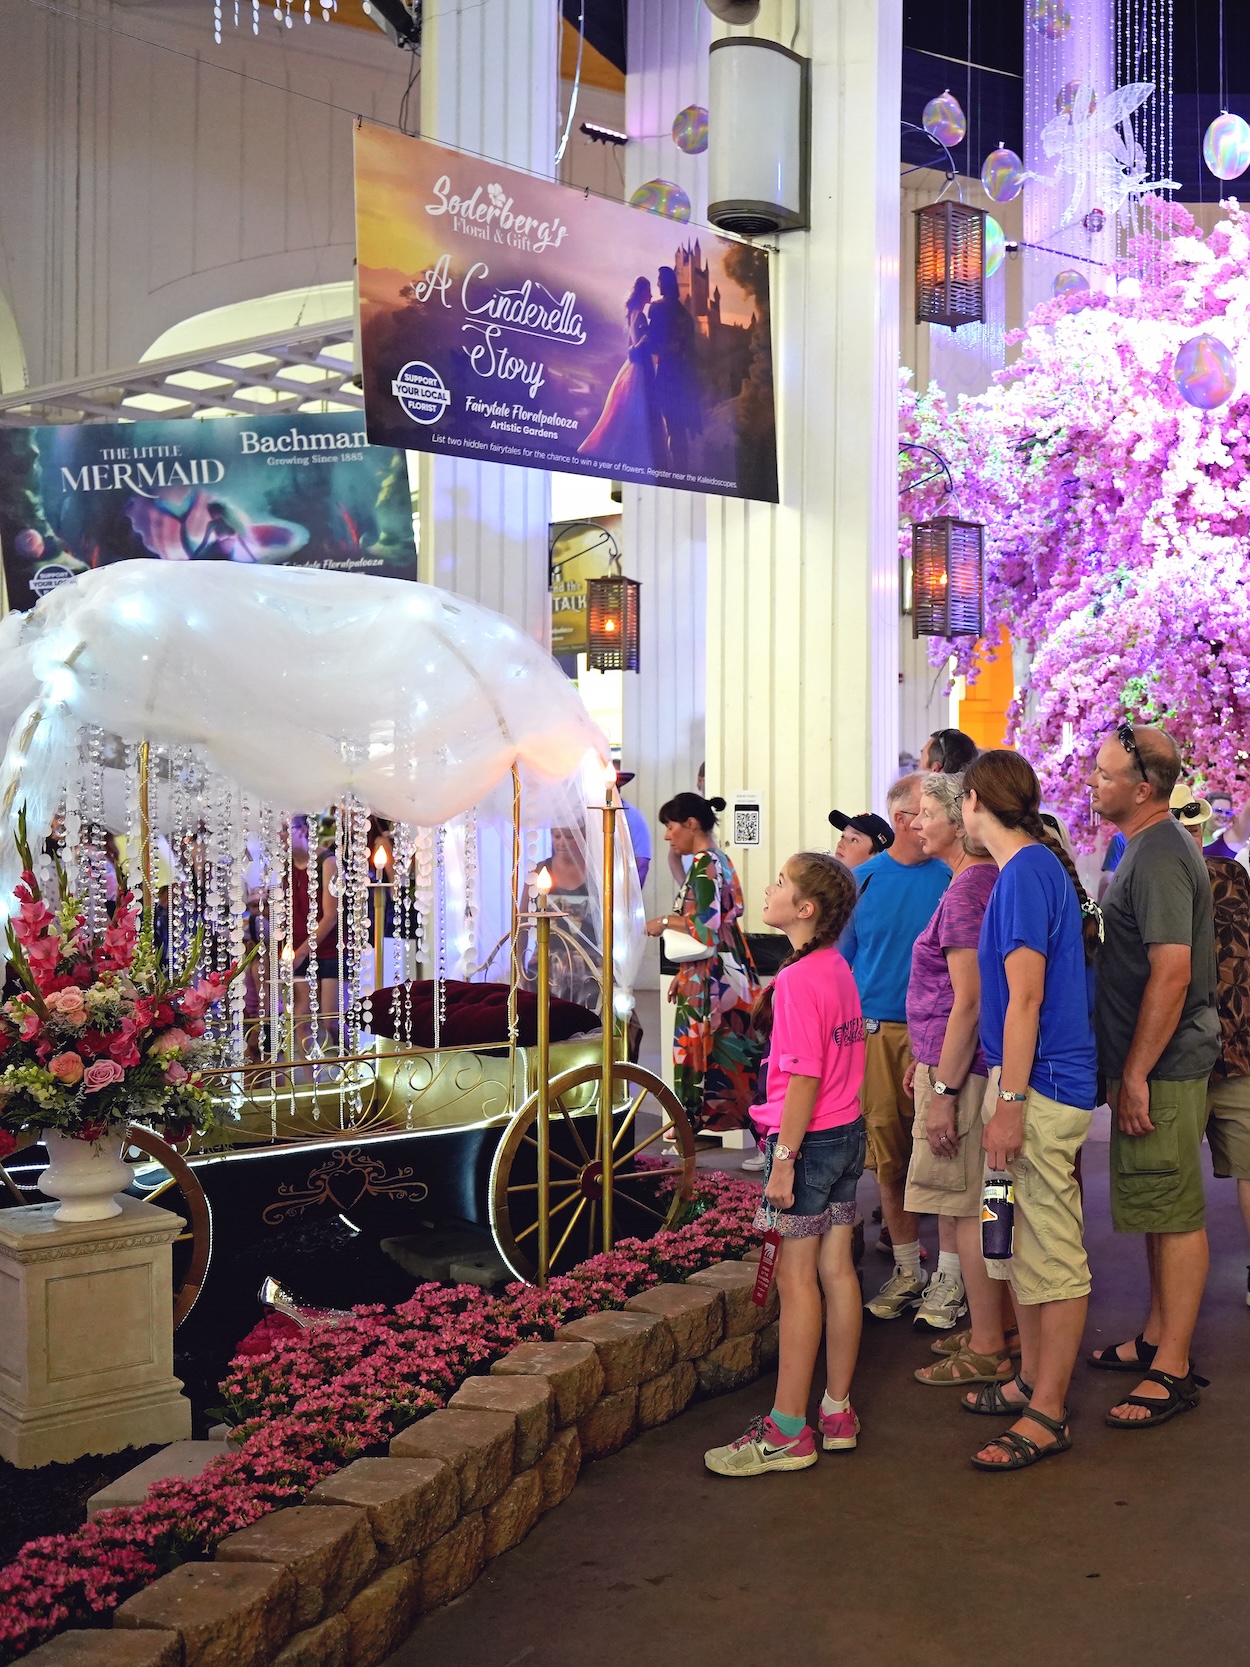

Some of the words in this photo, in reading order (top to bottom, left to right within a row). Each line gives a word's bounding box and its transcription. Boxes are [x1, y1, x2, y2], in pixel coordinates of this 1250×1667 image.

[424, 175, 569, 253] Soderberg's
[453, 216, 490, 242] Floral
[494, 228, 503, 244] &
[506, 231, 532, 251] Gift
[409, 254, 452, 308] A
[461, 262, 587, 345] Cinderella
[461, 322, 545, 399] Story
[396, 385, 419, 397] YOUR
[421, 390, 447, 401] LOCAL
[404, 373, 437, 387] SUPPORT
[408, 401, 437, 413] FLORIST
[465, 395, 510, 418] Fairytale
[512, 404, 579, 429] Floralpalooza
[239, 428, 372, 454] Bachman
[490, 420, 522, 434] Artistic
[523, 426, 558, 440] Gardens
[100, 446, 131, 462] THE
[133, 444, 182, 460] LITTLE
[267, 455, 309, 466] Growing
[312, 454, 338, 463] Since
[341, 452, 363, 462] 1885
[432, 433, 446, 445] List
[447, 437, 462, 447] two
[463, 438, 488, 450] hidden
[489, 442, 521, 457] fairytales
[523, 447, 533, 457] for
[534, 449, 545, 460] the
[547, 451, 571, 463] chance
[571, 456, 579, 465] to
[580, 459, 592, 467] win
[598, 461, 613, 470] year
[614, 462, 621, 471] of
[622, 463, 645, 475] flowers.
[647, 467, 672, 479] Register
[673, 473, 686, 481] near
[686, 474, 696, 482] the
[697, 475, 738, 489] Kaleidoscopes.
[60, 458, 225, 499] MERMAID
[553, 595, 588, 613] TALK
